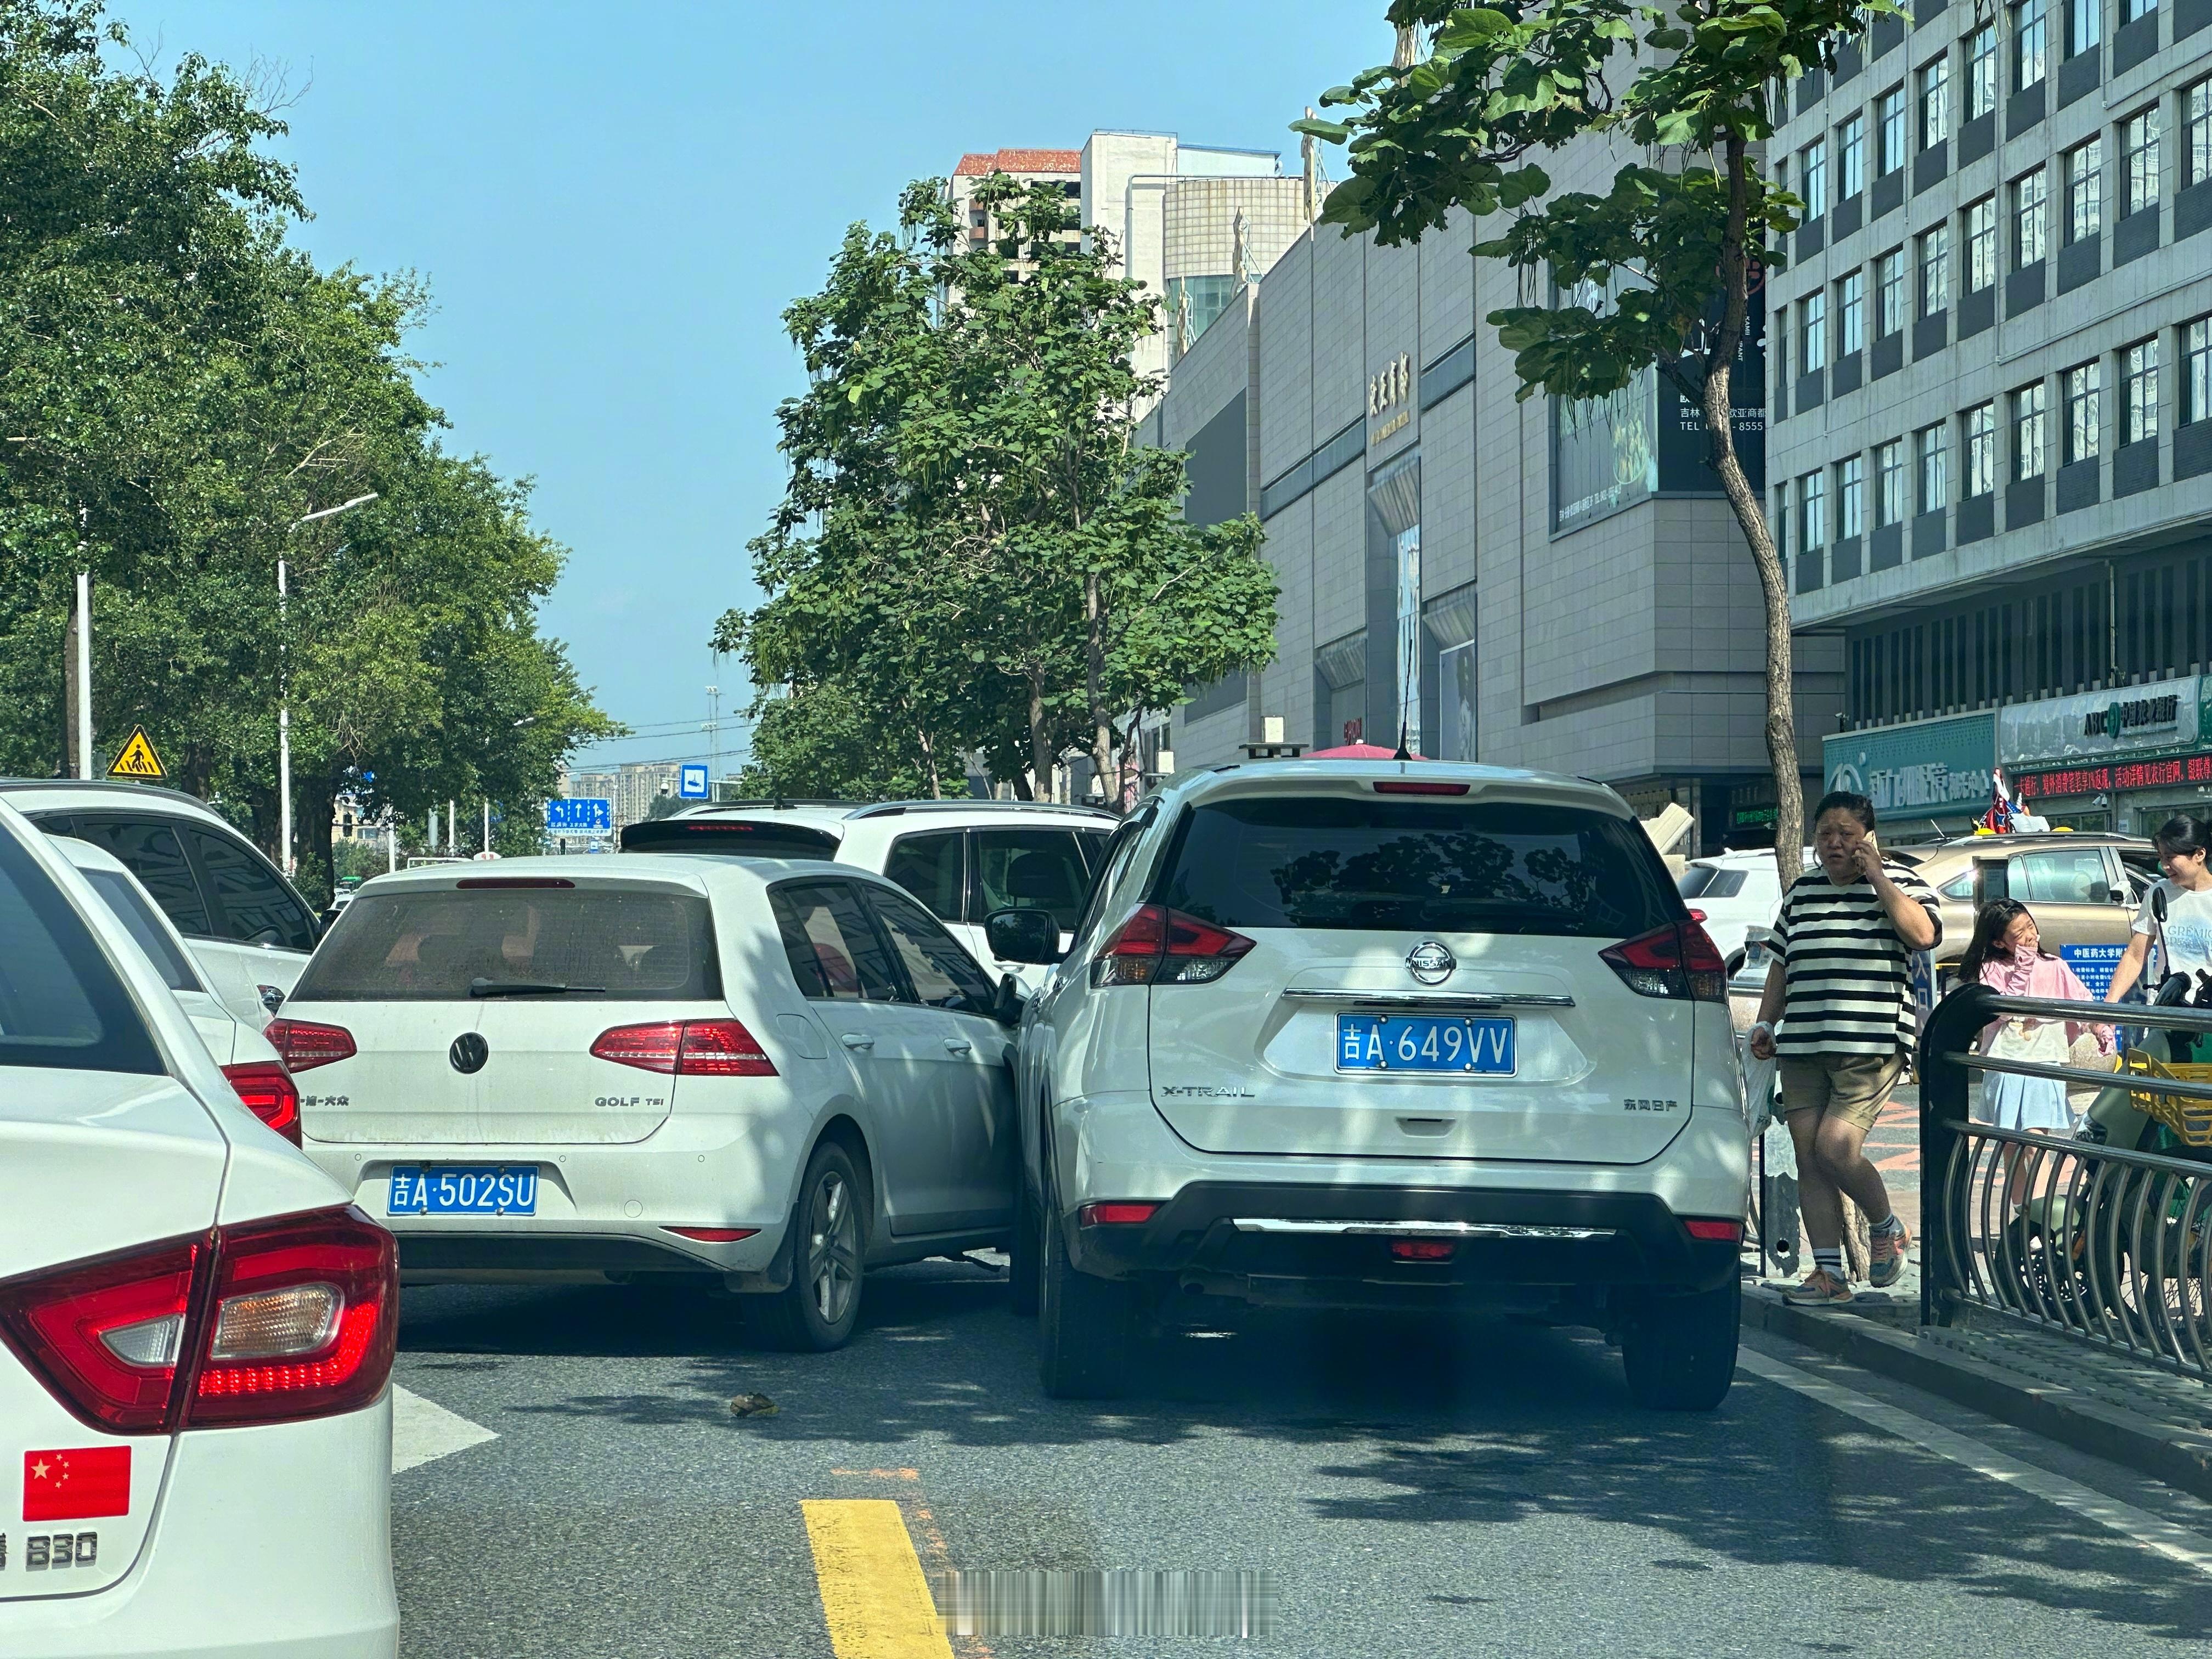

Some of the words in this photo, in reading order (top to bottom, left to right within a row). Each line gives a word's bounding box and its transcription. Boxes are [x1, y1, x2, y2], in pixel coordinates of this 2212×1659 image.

[1680, 408, 1701, 418] 吉林
[1680, 422, 1700, 431] TEL
[2084, 710, 2108, 736] ABC
[2121, 695, 2178, 728] 中国农业银行
[2074, 948, 2128, 958] 中医药大学附
[1411, 960, 1452, 968] NISSAN
[1342, 1023, 1508, 1064] 吉A·649VV
[1161, 1086, 1255, 1097] X-TRAIL
[595, 1097, 640, 1107] GOLF
[1624, 1098, 1678, 1111] 东风日产
[393, 1173, 535, 1207] 吉A·502SU
